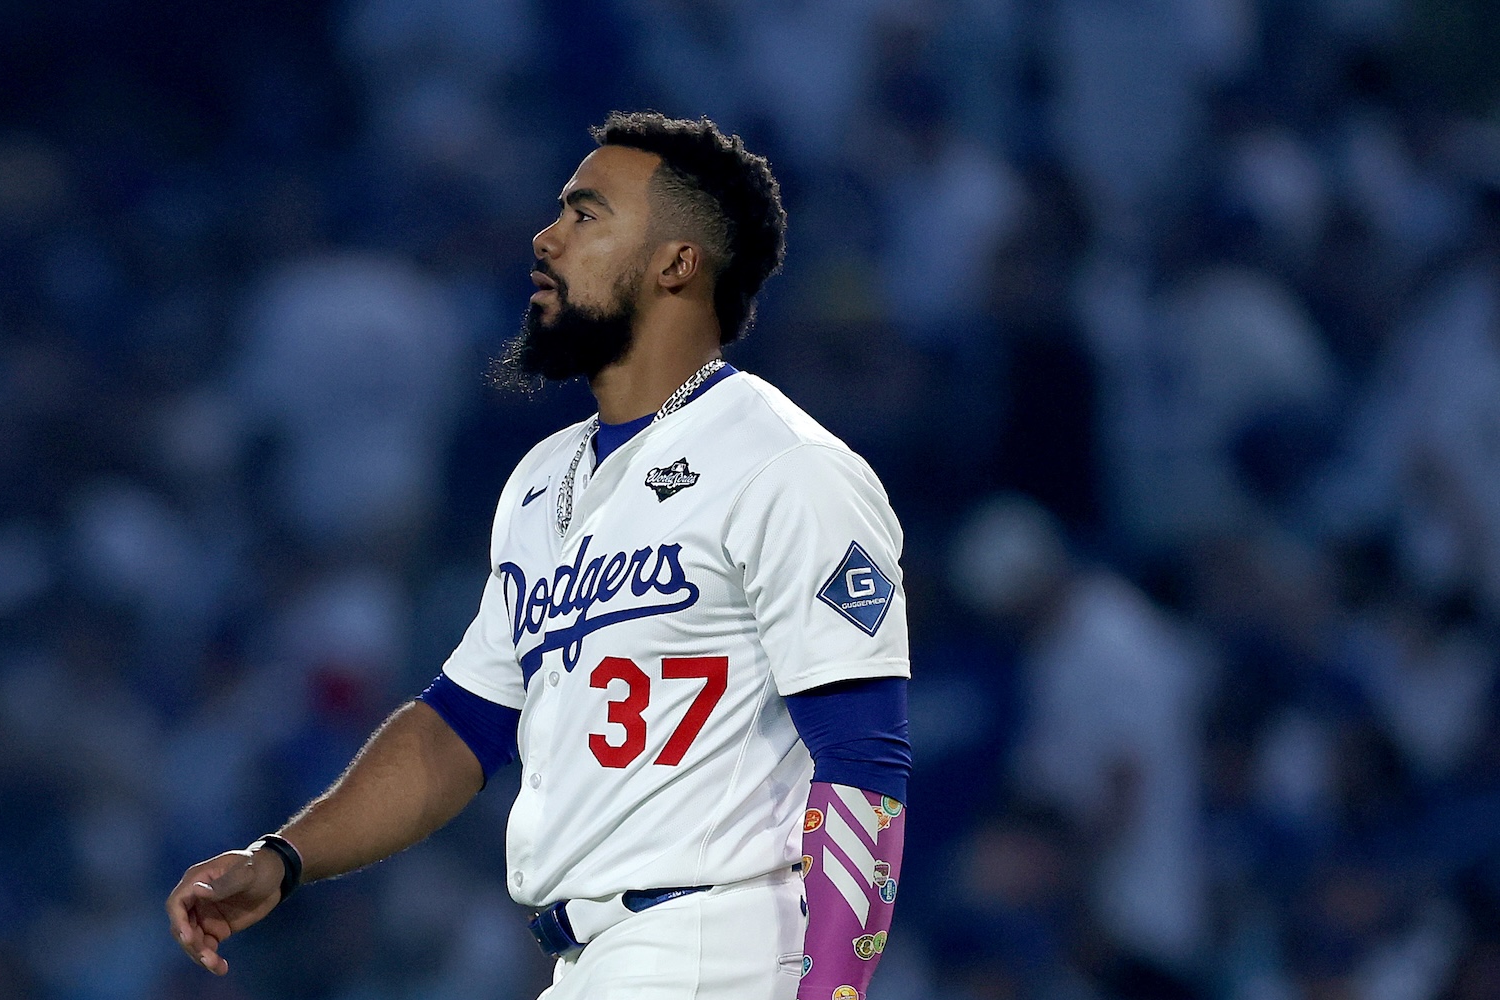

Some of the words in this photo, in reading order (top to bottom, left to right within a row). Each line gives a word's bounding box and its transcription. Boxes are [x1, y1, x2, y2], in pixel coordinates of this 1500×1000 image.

[499, 534, 699, 693] Dodgers
[845, 567, 876, 598] G
[588, 656, 729, 768] 37
